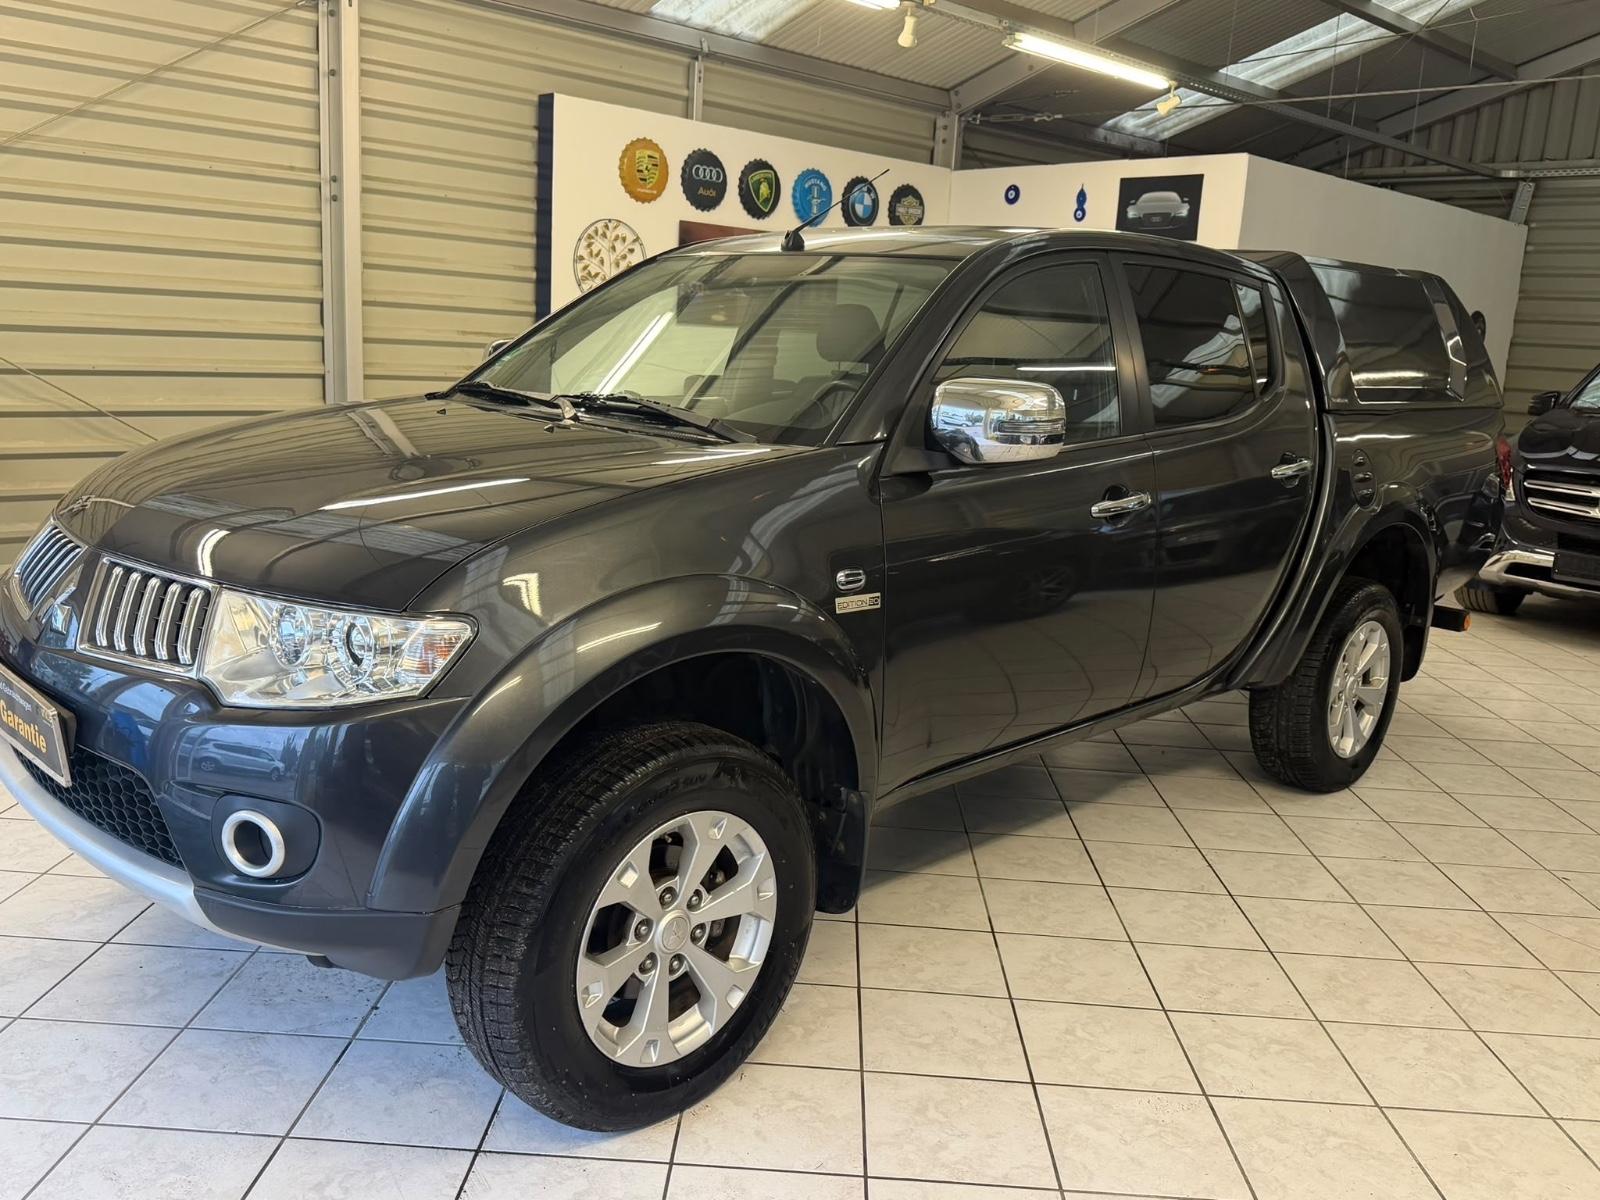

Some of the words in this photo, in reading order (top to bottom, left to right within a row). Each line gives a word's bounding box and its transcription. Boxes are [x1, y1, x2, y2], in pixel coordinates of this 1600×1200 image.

[697, 186, 717, 198] Audi
[837, 598, 867, 610] EDITION
[0, 699, 47, 753] Garantie
